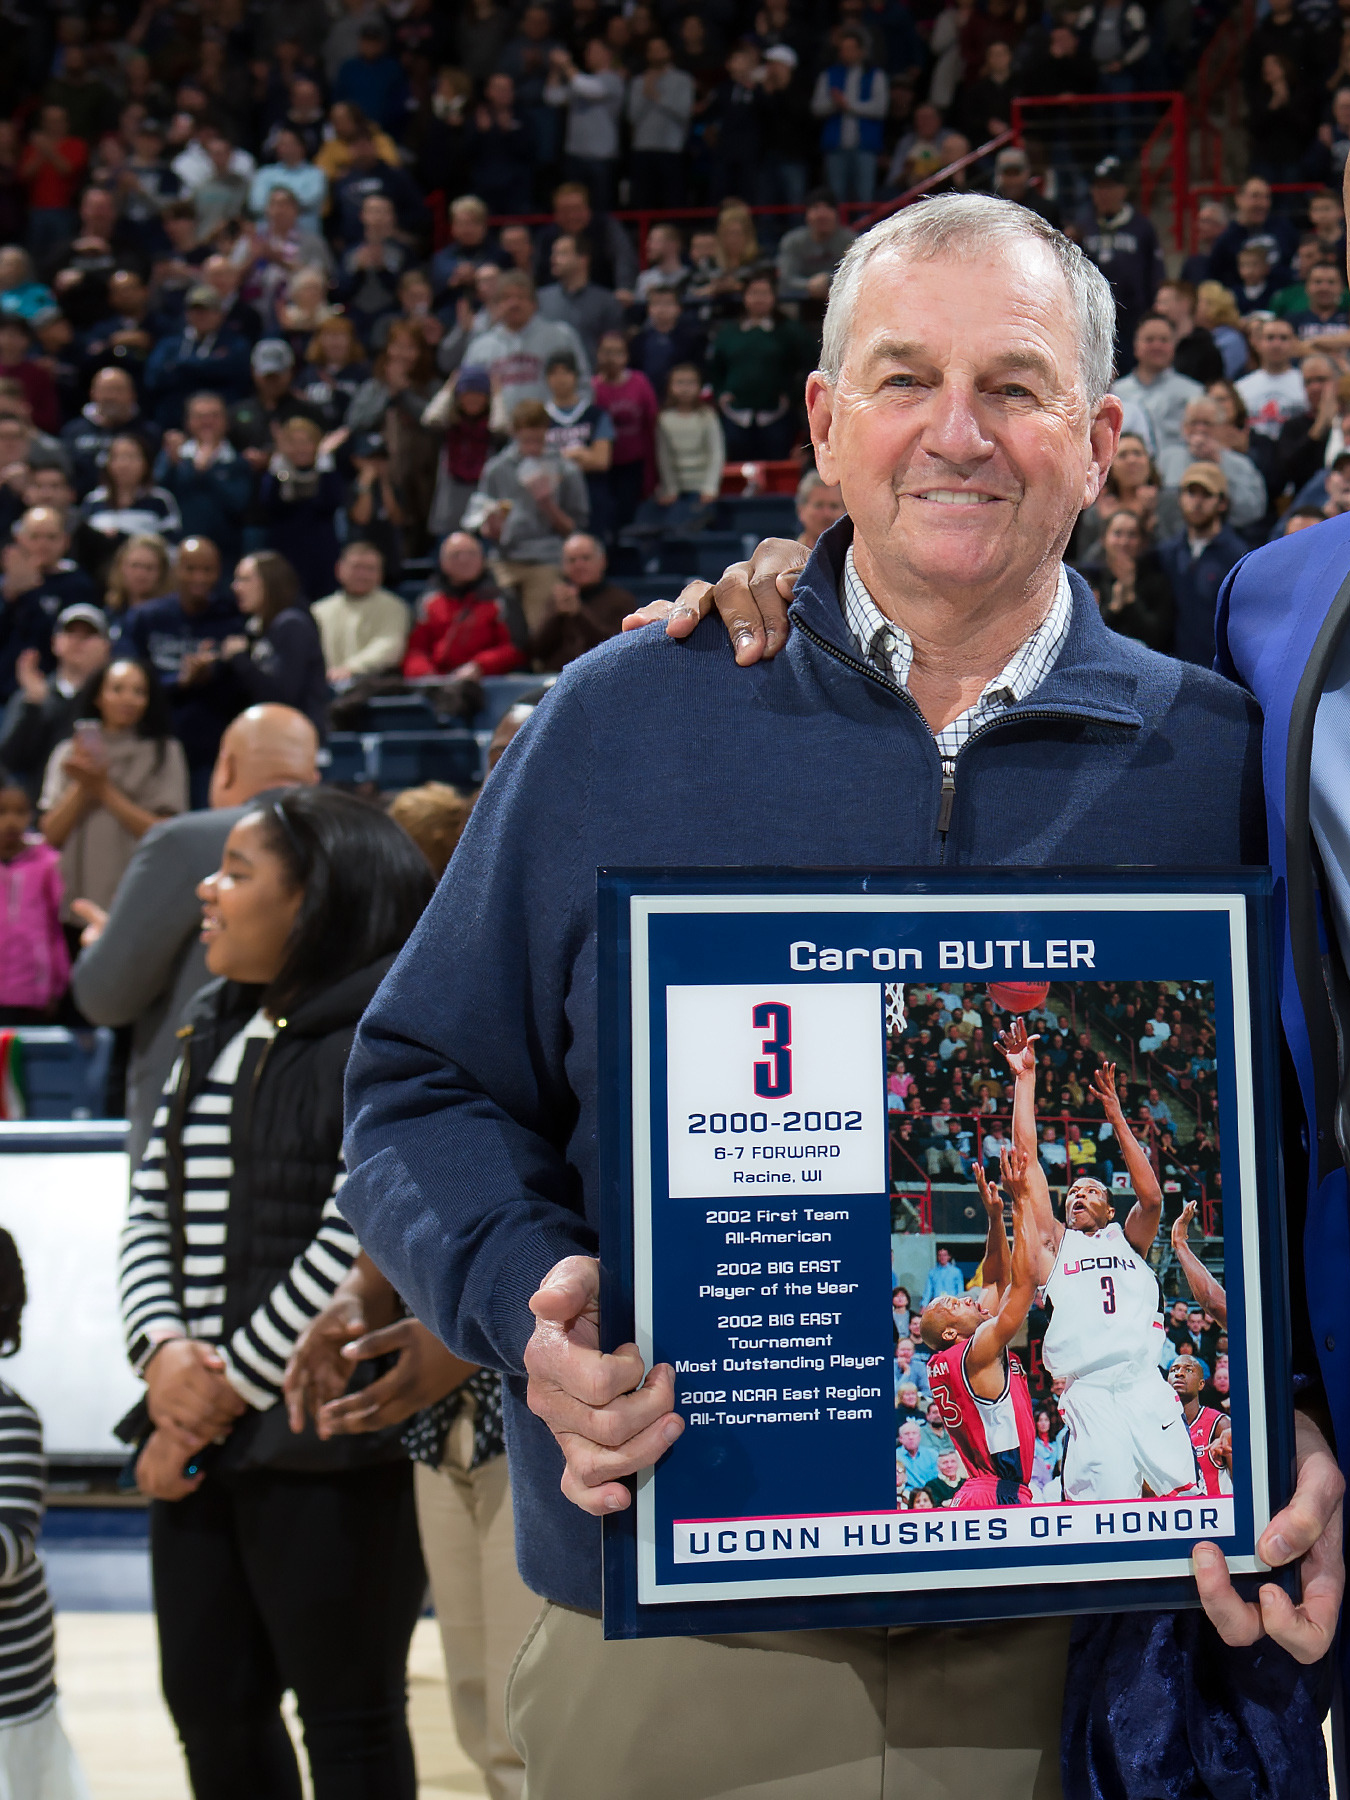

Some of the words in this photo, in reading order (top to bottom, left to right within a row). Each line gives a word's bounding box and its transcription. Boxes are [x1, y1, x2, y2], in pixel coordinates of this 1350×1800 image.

[790, 940, 923, 971] Caron
[938, 939, 1096, 970] BUTLER
[752, 1001, 793, 1100] 3
[688, 1110, 862, 1134] 2000-2002
[714, 1146, 745, 1160] 6-7
[752, 1145, 841, 1159] FORWARD
[733, 1170, 796, 1184] Racine,
[801, 1170, 822, 1182] WI
[706, 1210, 751, 1223] 2002
[756, 1209, 798, 1222] First
[803, 1208, 850, 1221] Team
[725, 1230, 832, 1244] All-American
[716, 1263, 762, 1276] 2002
[767, 1261, 794, 1274] BIG
[799, 1260, 841, 1273] EAST
[699, 1284, 755, 1300] Player
[760, 1283, 779, 1295] of
[784, 1282, 812, 1295] the
[817, 1282, 859, 1294] Year
[1100, 1276, 1116, 1315] 3
[717, 1315, 763, 1328] 2002
[768, 1313, 795, 1327] BIG
[800, 1312, 842, 1326] EAST
[728, 1334, 833, 1349] Tournament
[675, 1359, 718, 1373] Most
[723, 1356, 825, 1372] Outstanding
[830, 1354, 885, 1370] Player
[681, 1391, 726, 1404] 2002
[732, 1388, 777, 1402] NCAA
[782, 1387, 820, 1401] East
[825, 1385, 881, 1401] Region
[690, 1408, 821, 1426] All-Tournament
[826, 1407, 873, 1420] Team
[689, 1526, 820, 1555] UCONN
[844, 1517, 1008, 1547] HUSKIES
[1030, 1515, 1073, 1538] OF
[1095, 1508, 1219, 1535] HONOR
